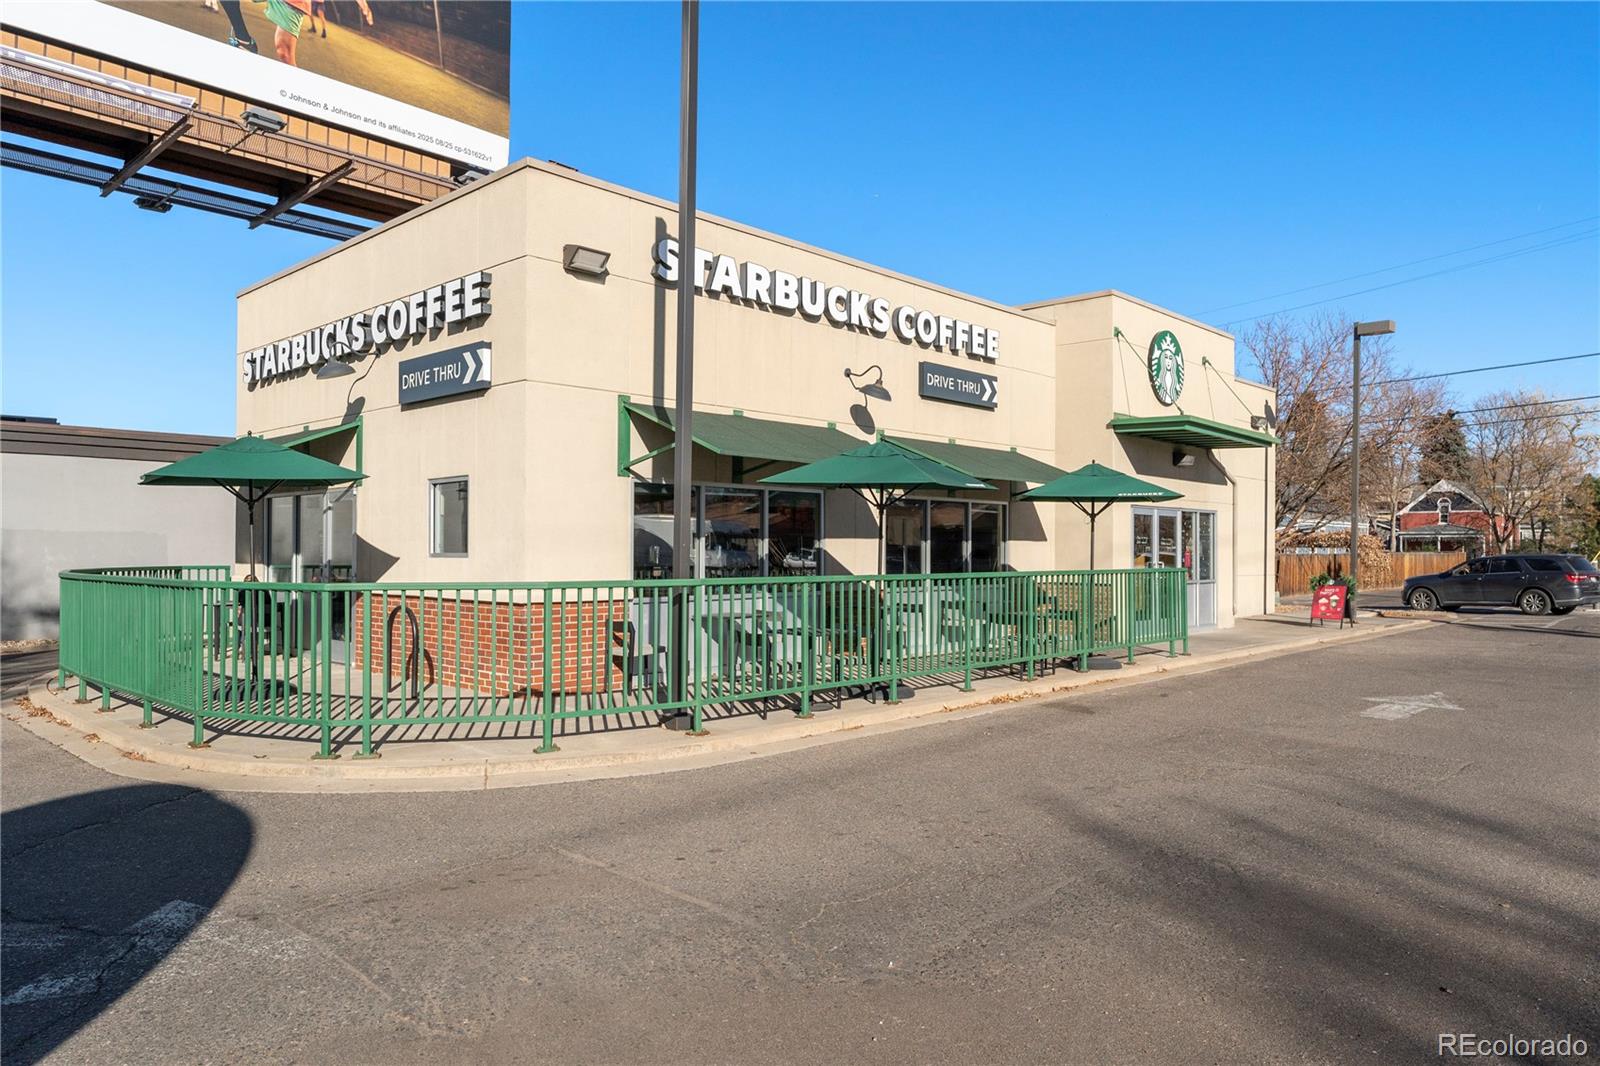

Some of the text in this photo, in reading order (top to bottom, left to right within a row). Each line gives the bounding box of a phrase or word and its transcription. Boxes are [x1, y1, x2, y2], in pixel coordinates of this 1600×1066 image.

[289, 93, 321, 109] Johnson
[331, 106, 361, 121] Johnson
[363, 116, 377, 127] and
[379, 121, 387, 130] its
[388, 124, 416, 138] affiliates
[417, 132, 434, 144] 2025
[658, 239, 1000, 359] STARBUCKS COFFEE
[243, 271, 485, 384] STARBUCKS COFFEE
[402, 362, 461, 390] DRIVE THRU
[926, 372, 981, 395] DRIVE THRU
